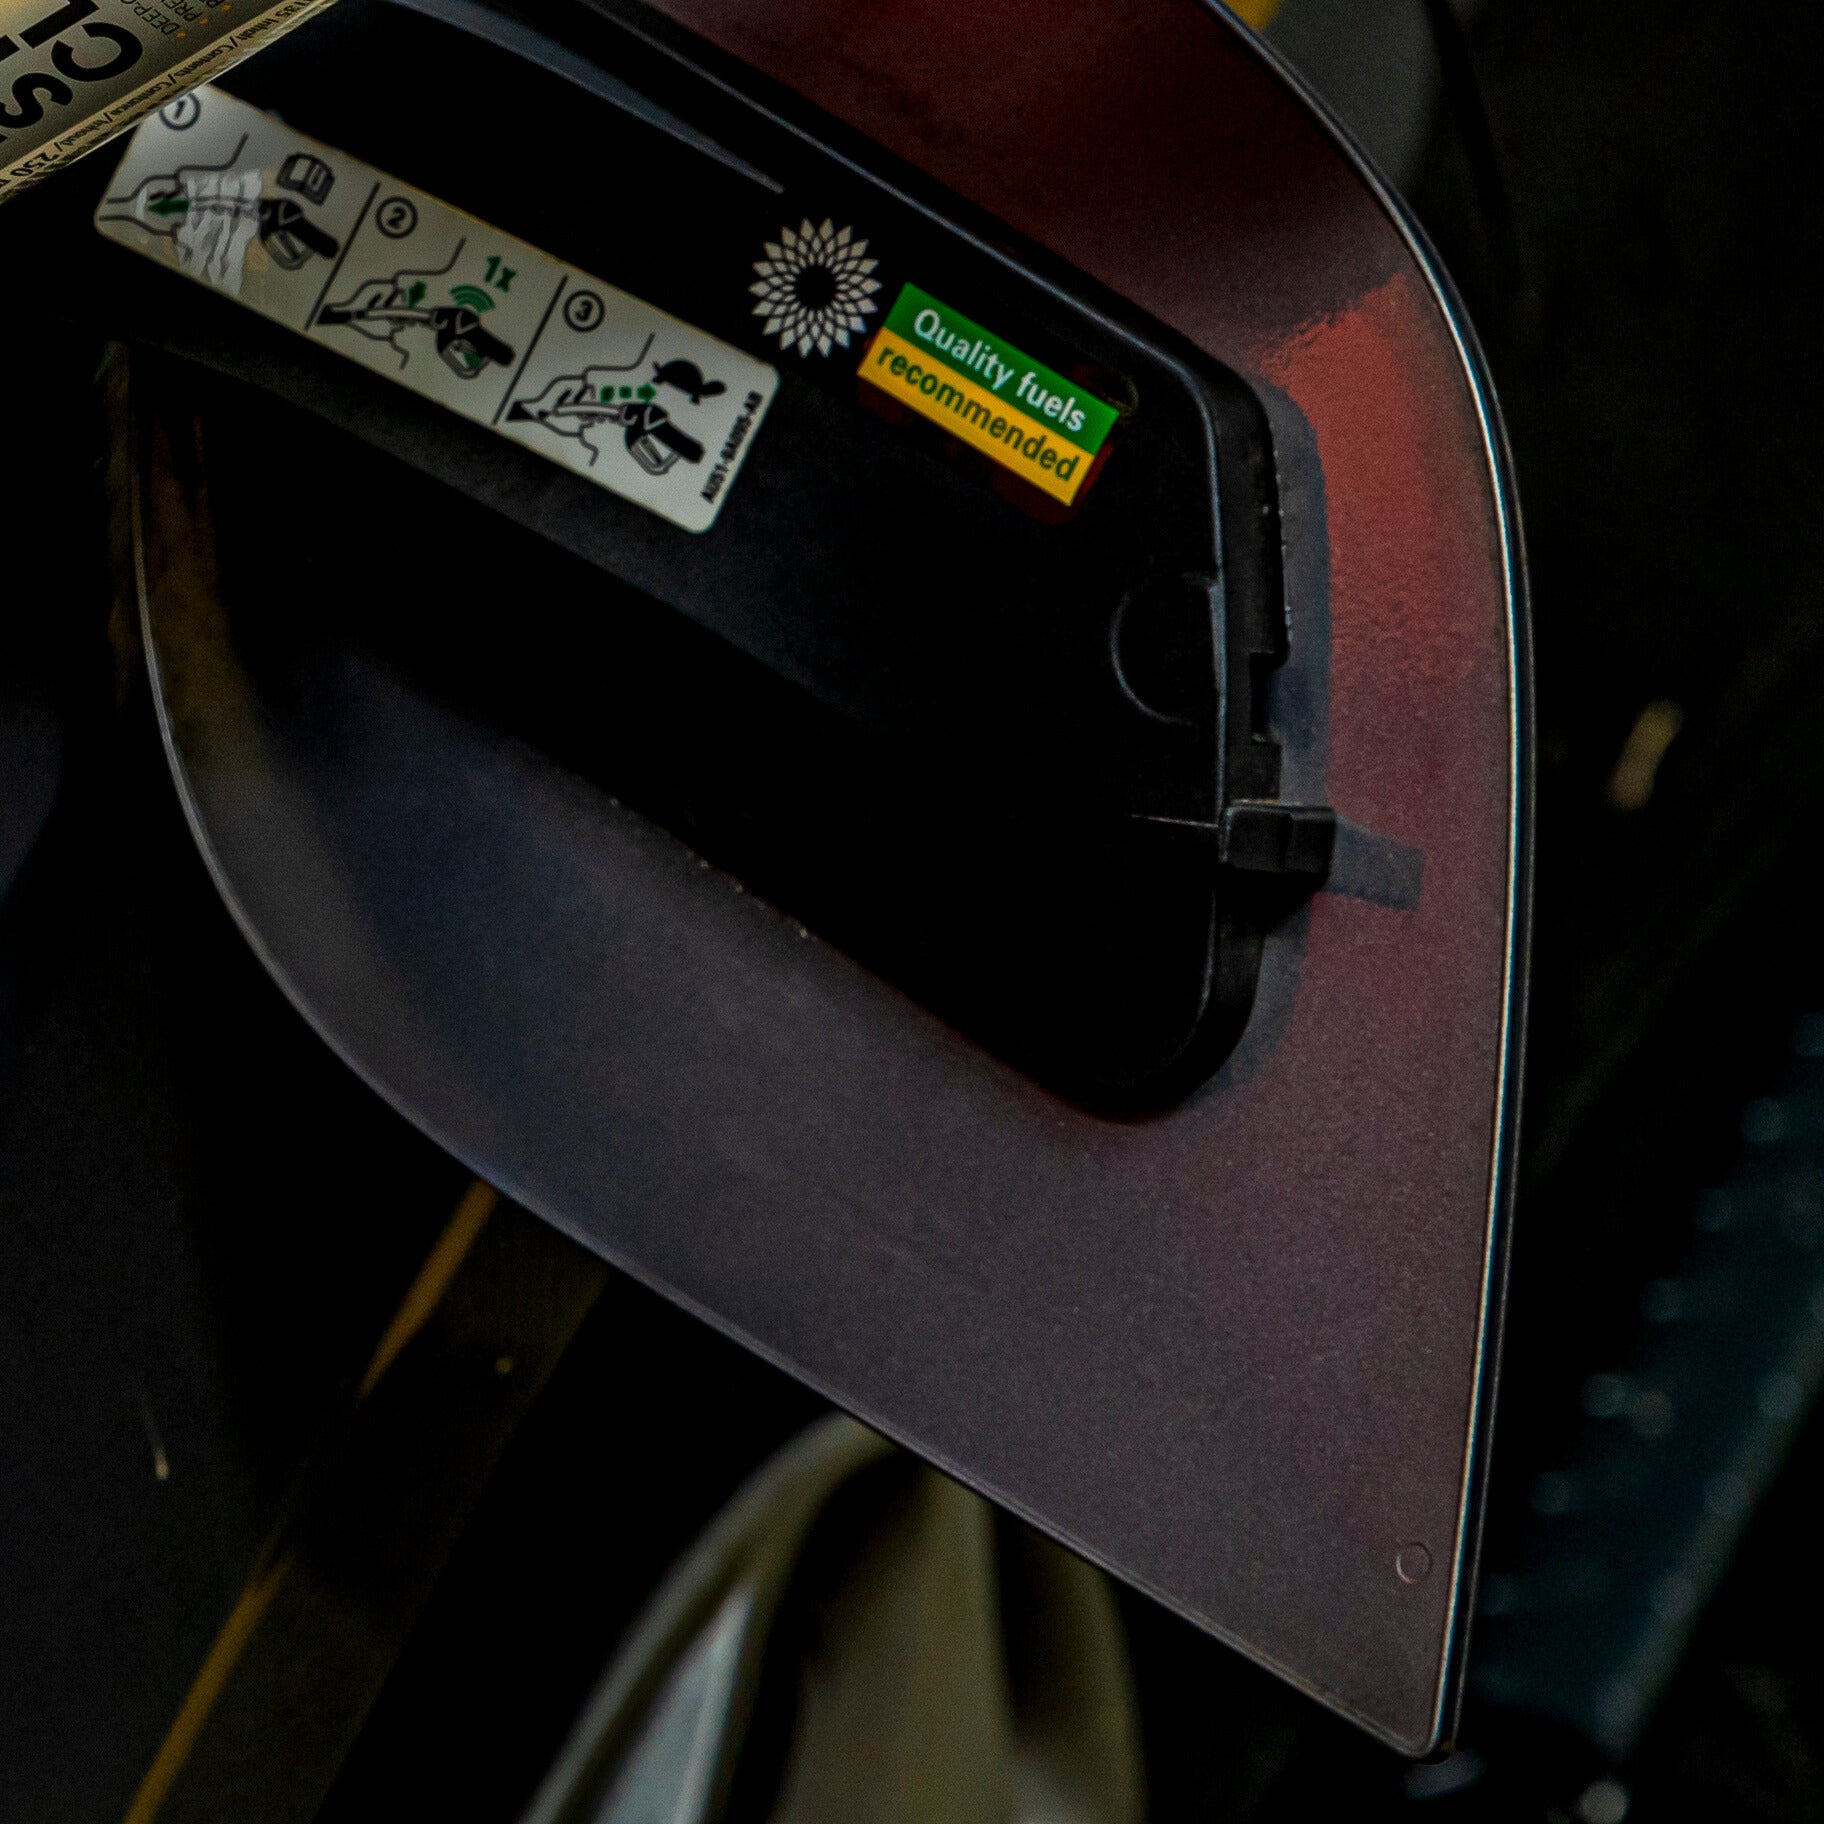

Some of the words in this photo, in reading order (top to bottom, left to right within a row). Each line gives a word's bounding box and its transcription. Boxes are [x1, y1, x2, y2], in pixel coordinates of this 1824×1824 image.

[876, 344, 1080, 483] recommended
[913, 308, 1016, 390] Quality
[1015, 371, 1086, 433] fuels
